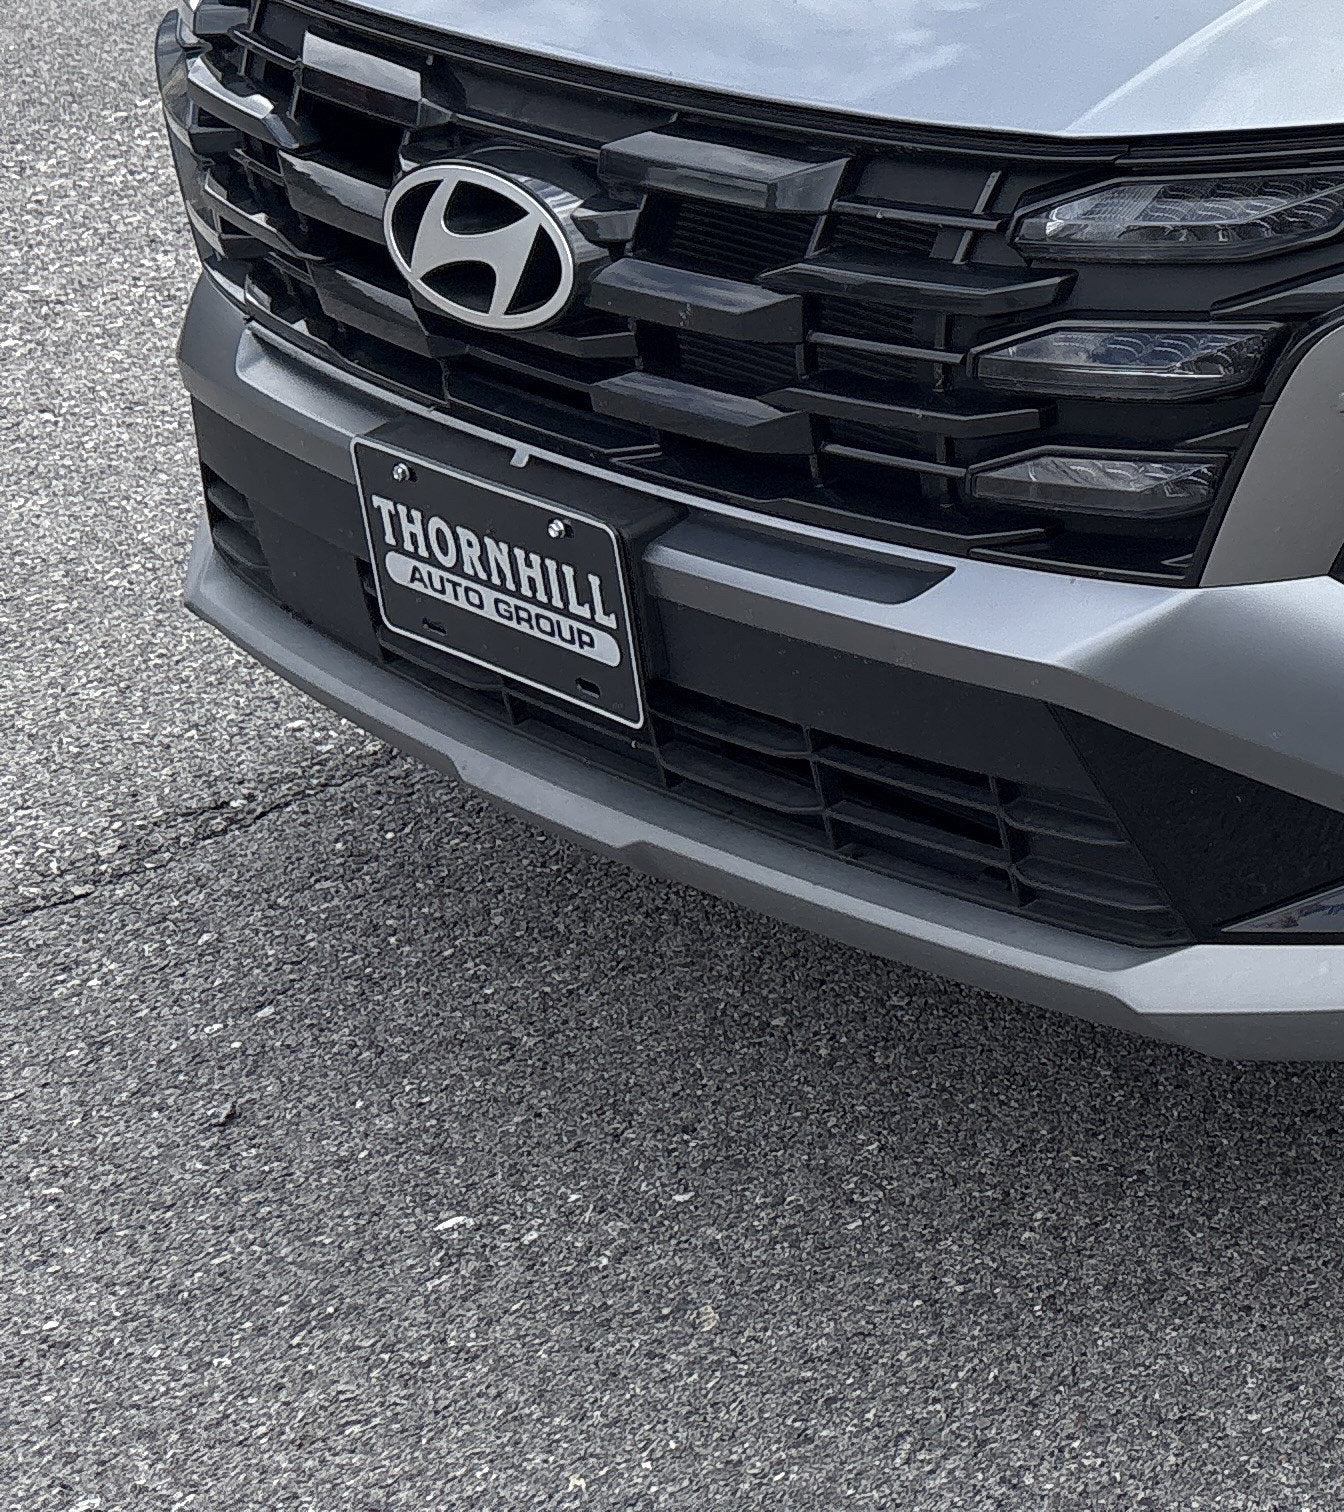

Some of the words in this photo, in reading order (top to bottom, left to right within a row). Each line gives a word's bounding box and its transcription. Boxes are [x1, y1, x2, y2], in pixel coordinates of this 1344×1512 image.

[371, 494, 618, 629] THORNHILL
[408, 564, 485, 612] AUTO
[493, 596, 596, 651] GROUP
